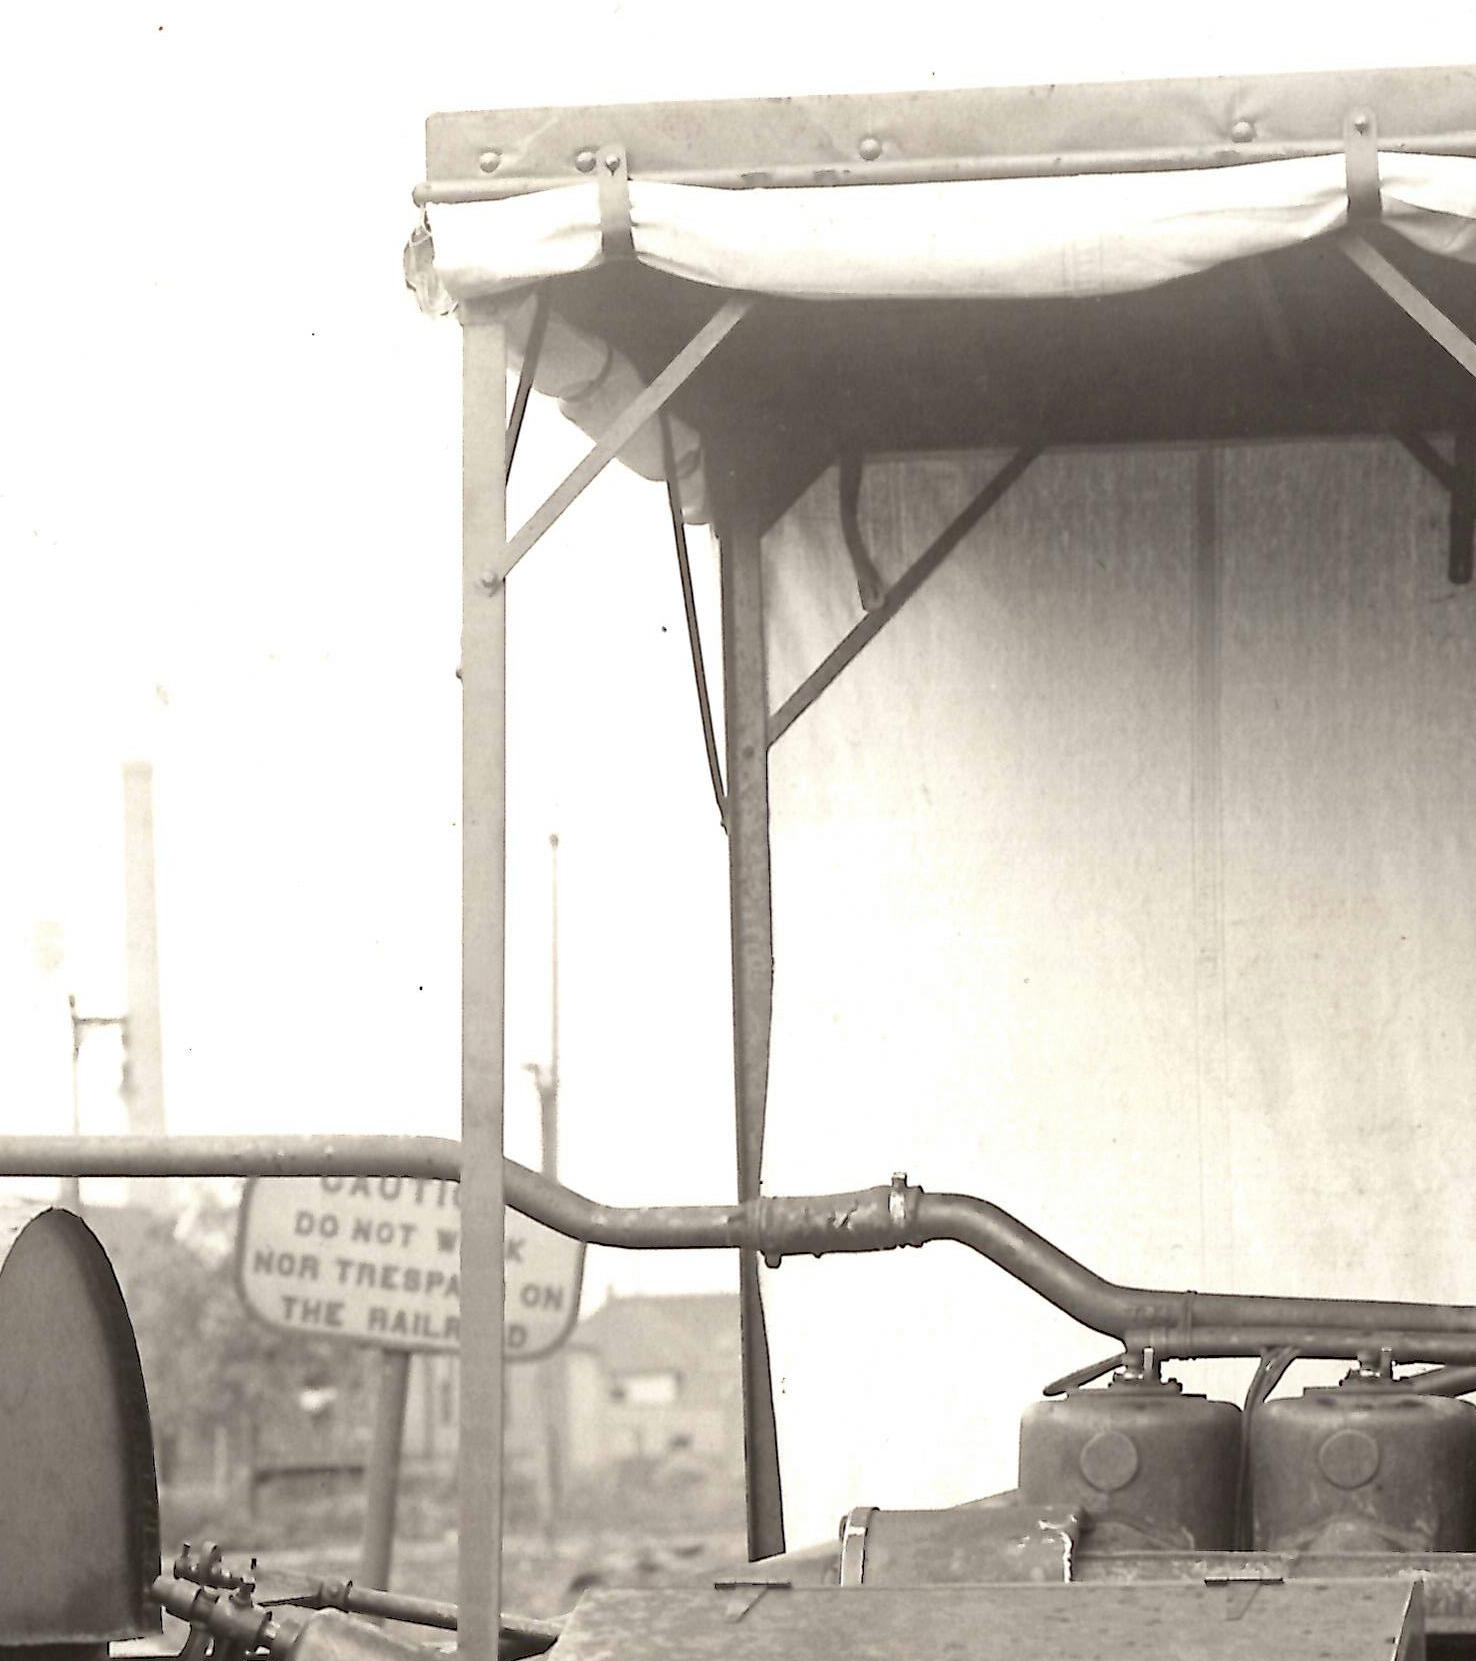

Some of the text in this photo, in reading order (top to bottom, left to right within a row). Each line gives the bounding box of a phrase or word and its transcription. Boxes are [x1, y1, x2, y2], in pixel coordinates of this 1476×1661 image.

[319, 1176, 460, 1207] CAUTI
[295, 1210, 525, 1263] DO NOT WK
[253, 1250, 564, 1312] NOR TRESPA ON
[281, 1295, 528, 1349] THE RAILRD
